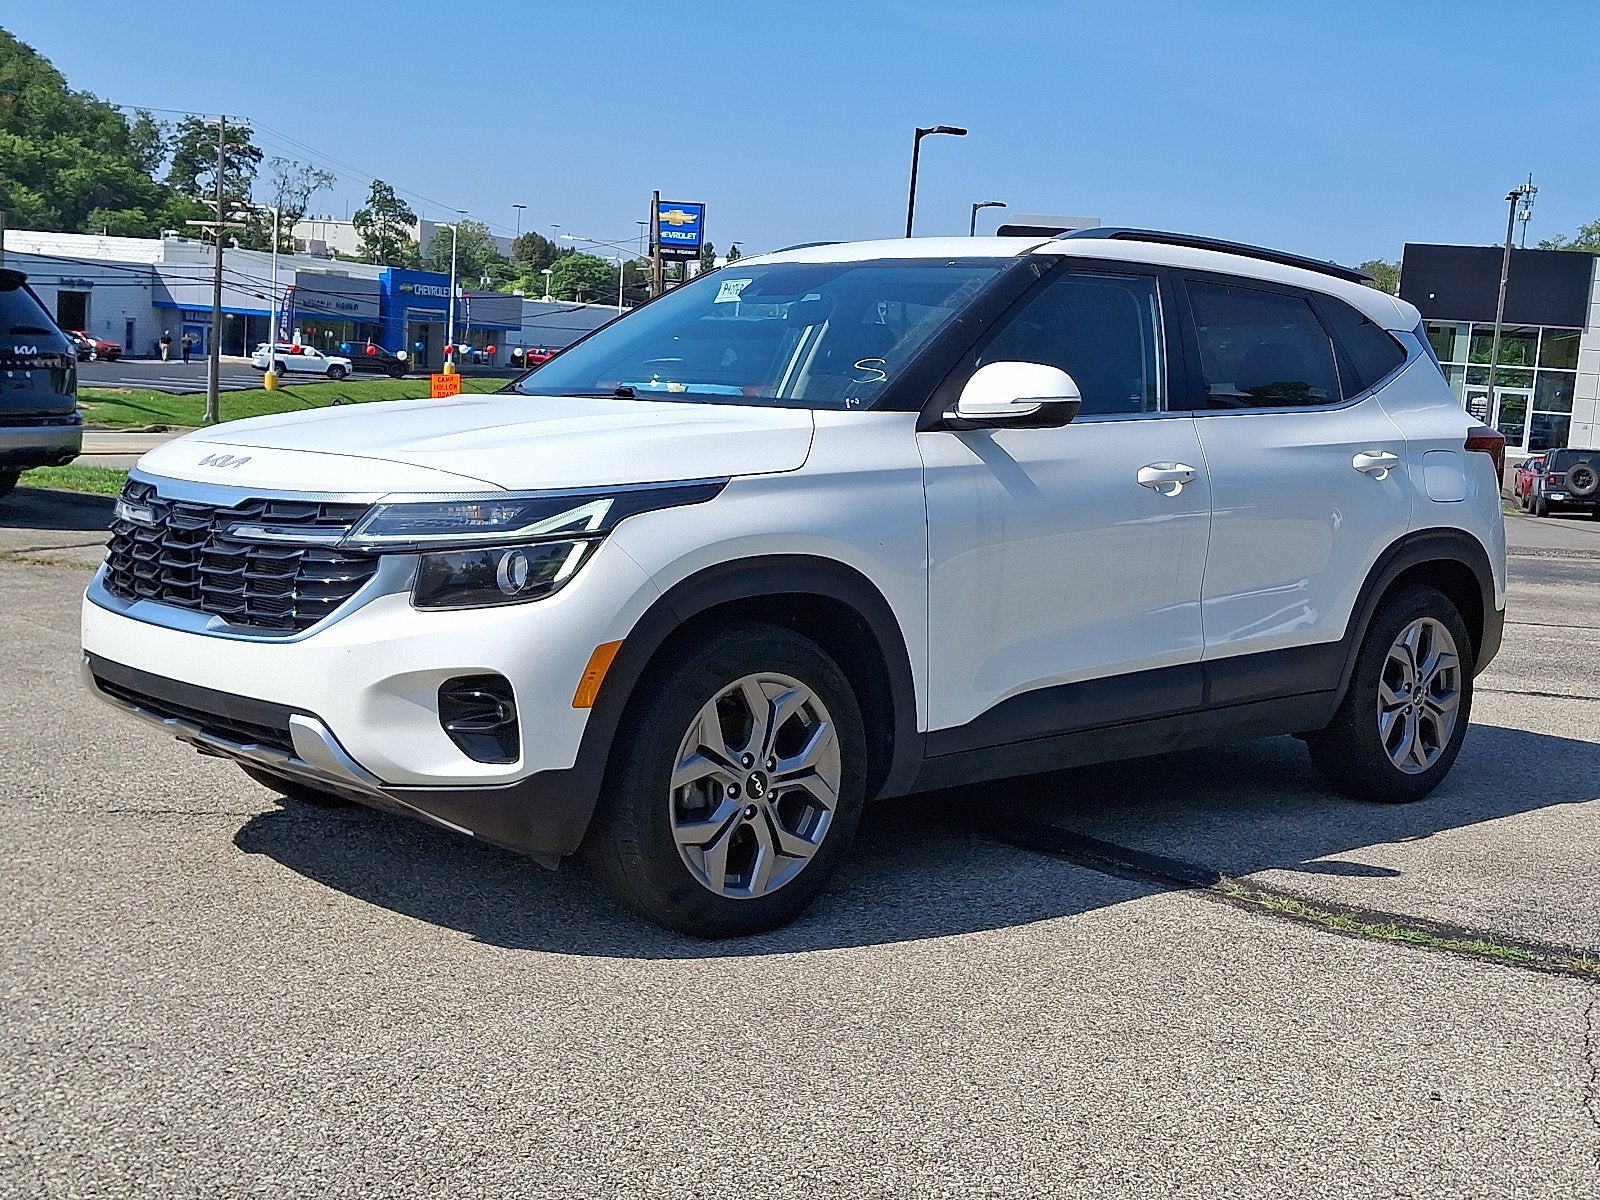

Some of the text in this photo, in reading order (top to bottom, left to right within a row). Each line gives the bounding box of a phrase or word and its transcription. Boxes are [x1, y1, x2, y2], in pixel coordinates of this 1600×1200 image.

[660, 231, 698, 240] HEVROLET
[14, 345, 38, 355] KIA
[198, 454, 252, 468] KIA
